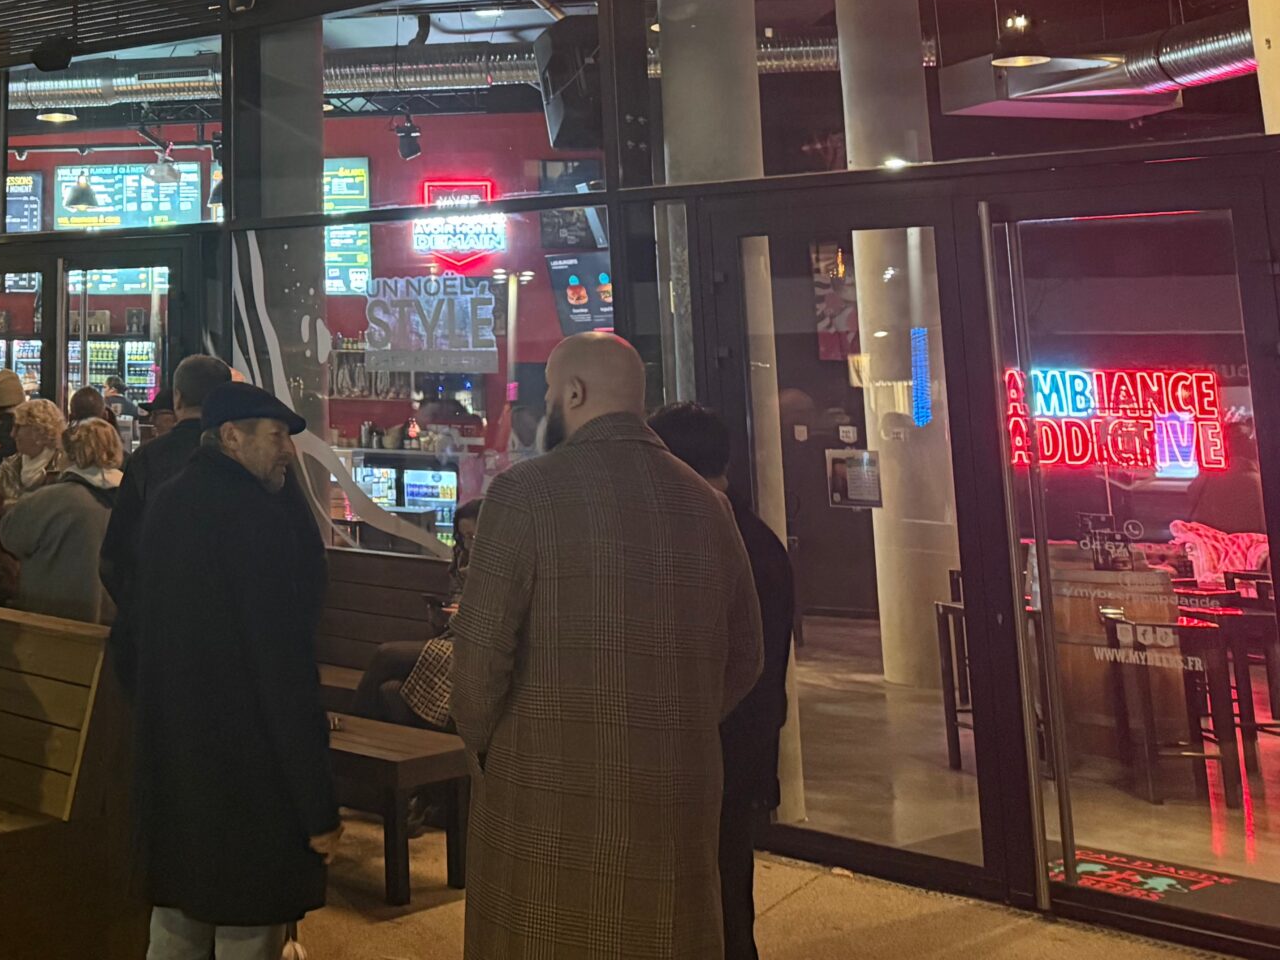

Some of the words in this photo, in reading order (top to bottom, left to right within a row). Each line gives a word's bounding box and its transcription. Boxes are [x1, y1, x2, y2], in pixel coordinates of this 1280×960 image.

[413, 233, 506, 250] DEMAIN
[366, 278, 399, 298] UN
[405, 271, 474, 297] NOËL
[1004, 368, 1219, 419] AMBIANCE
[1009, 417, 1227, 469] ADDICTIVE
[1093, 646, 1204, 672] WWW.MYBEERS.FR
